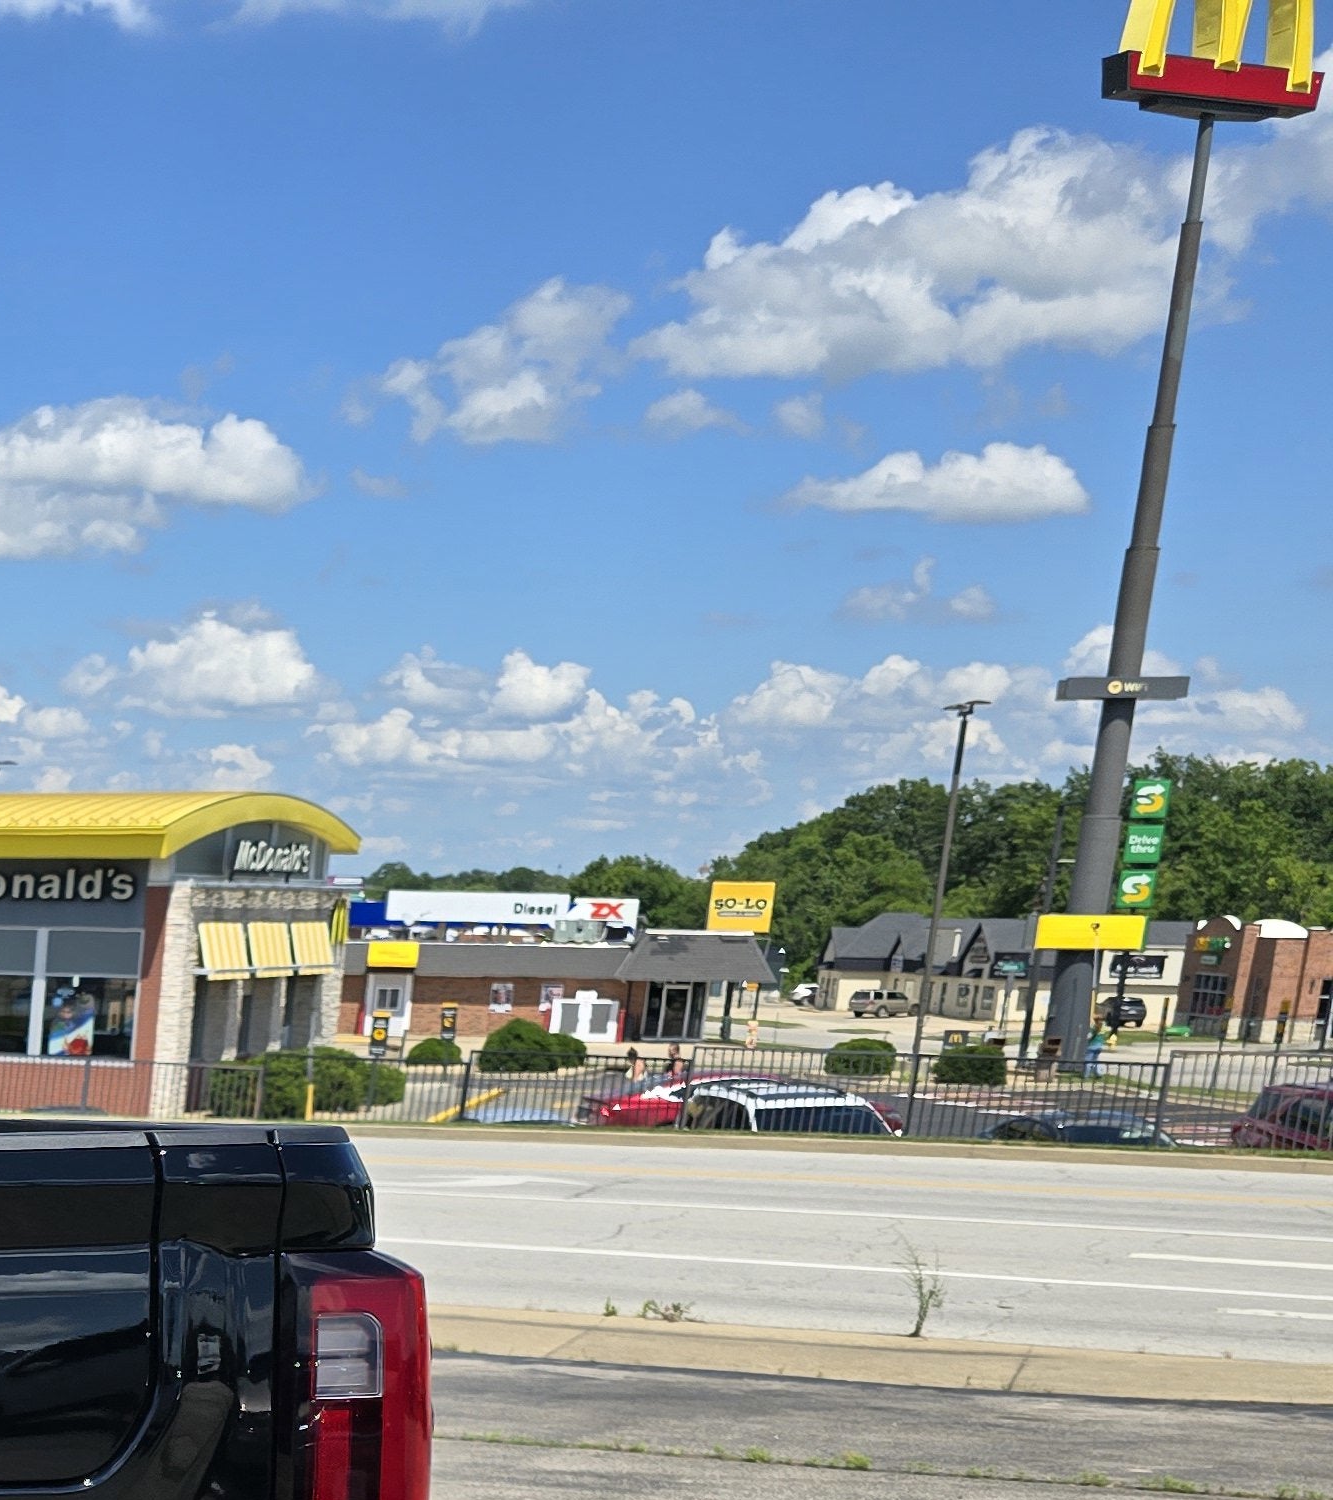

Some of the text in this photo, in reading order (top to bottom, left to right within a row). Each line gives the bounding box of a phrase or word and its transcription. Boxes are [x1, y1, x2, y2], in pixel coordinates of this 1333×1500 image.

[1128, 834, 1160, 845] Drive
[514, 903, 558, 915] Diesel
[714, 898, 767, 910] SO-LO
